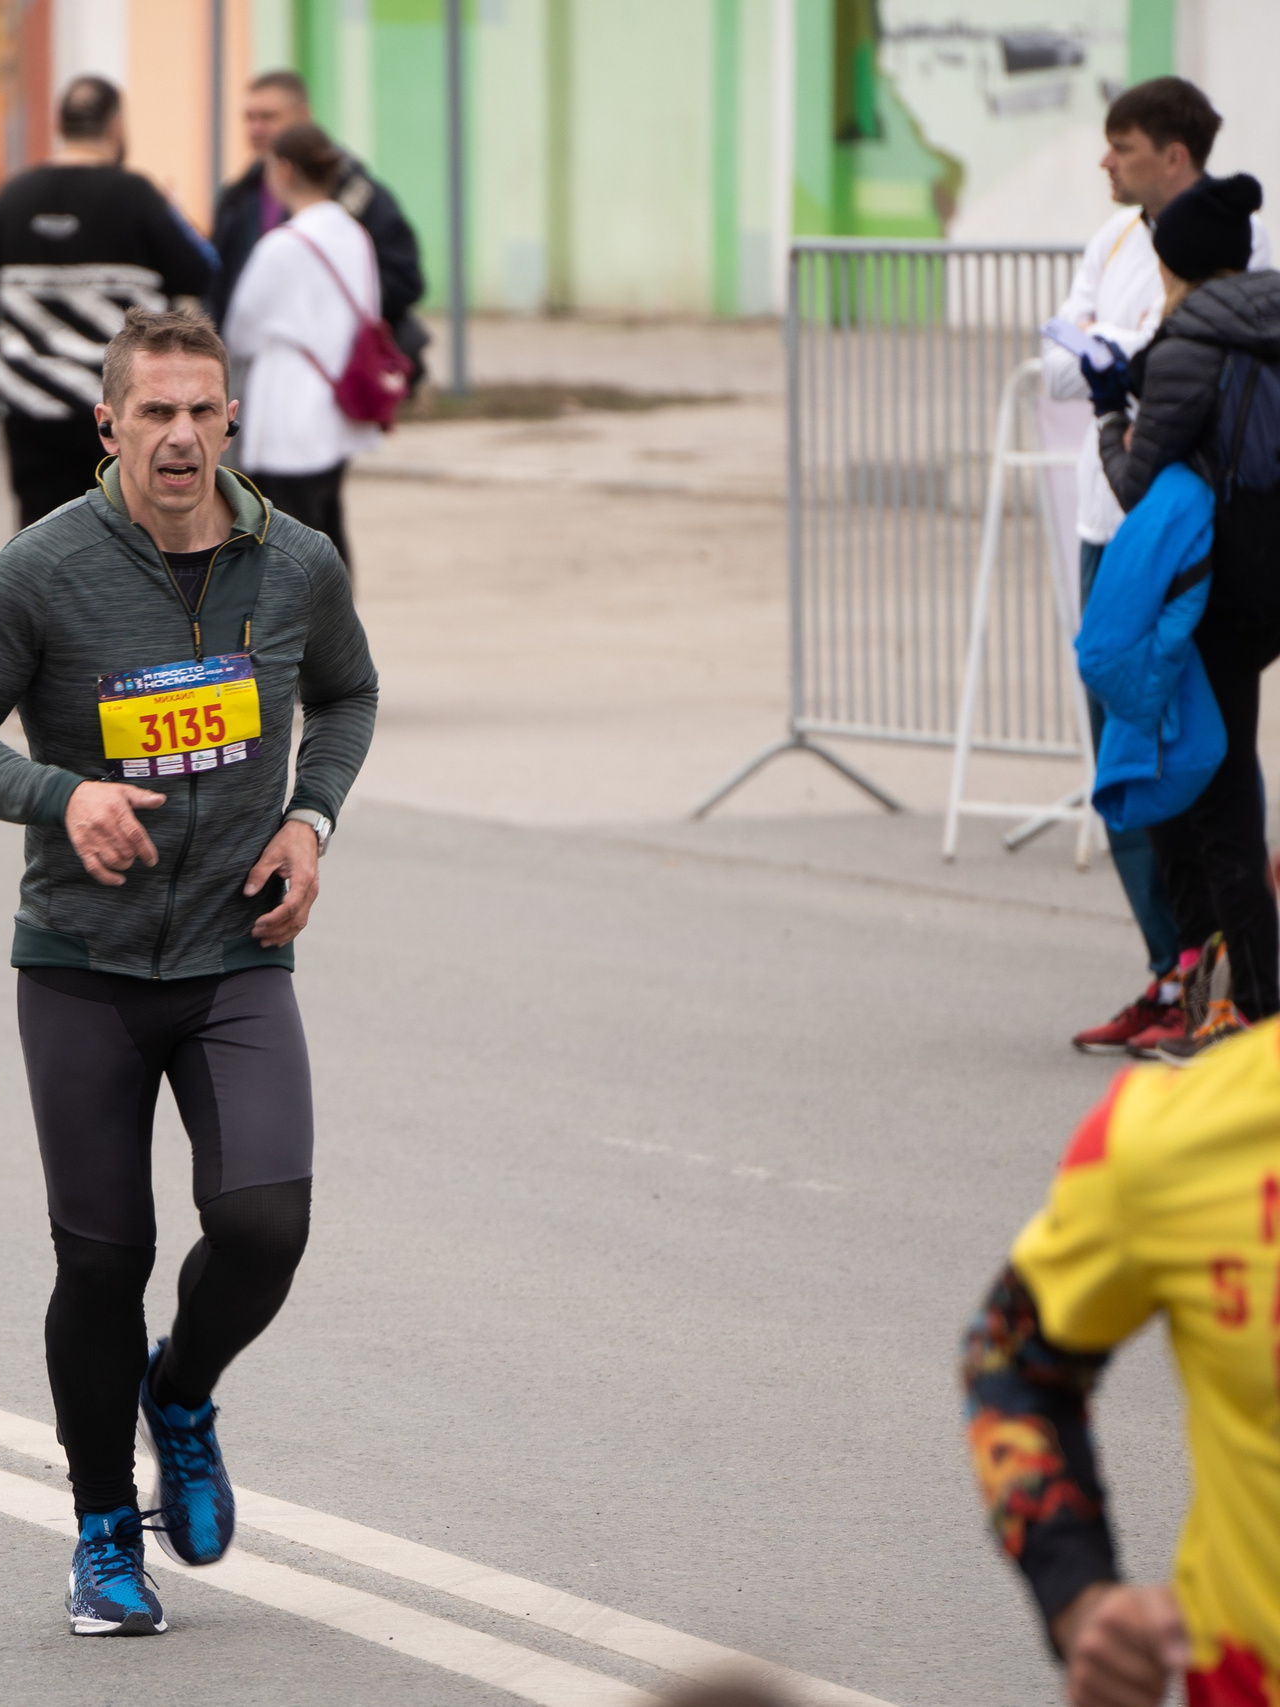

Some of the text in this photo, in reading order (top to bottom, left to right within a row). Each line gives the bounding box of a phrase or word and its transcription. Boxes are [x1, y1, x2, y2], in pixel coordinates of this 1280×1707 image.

[153, 665, 205, 680] ПРОСТО
[154, 691, 195, 704] МИХАИЛ
[139, 703, 226, 753] 3135
